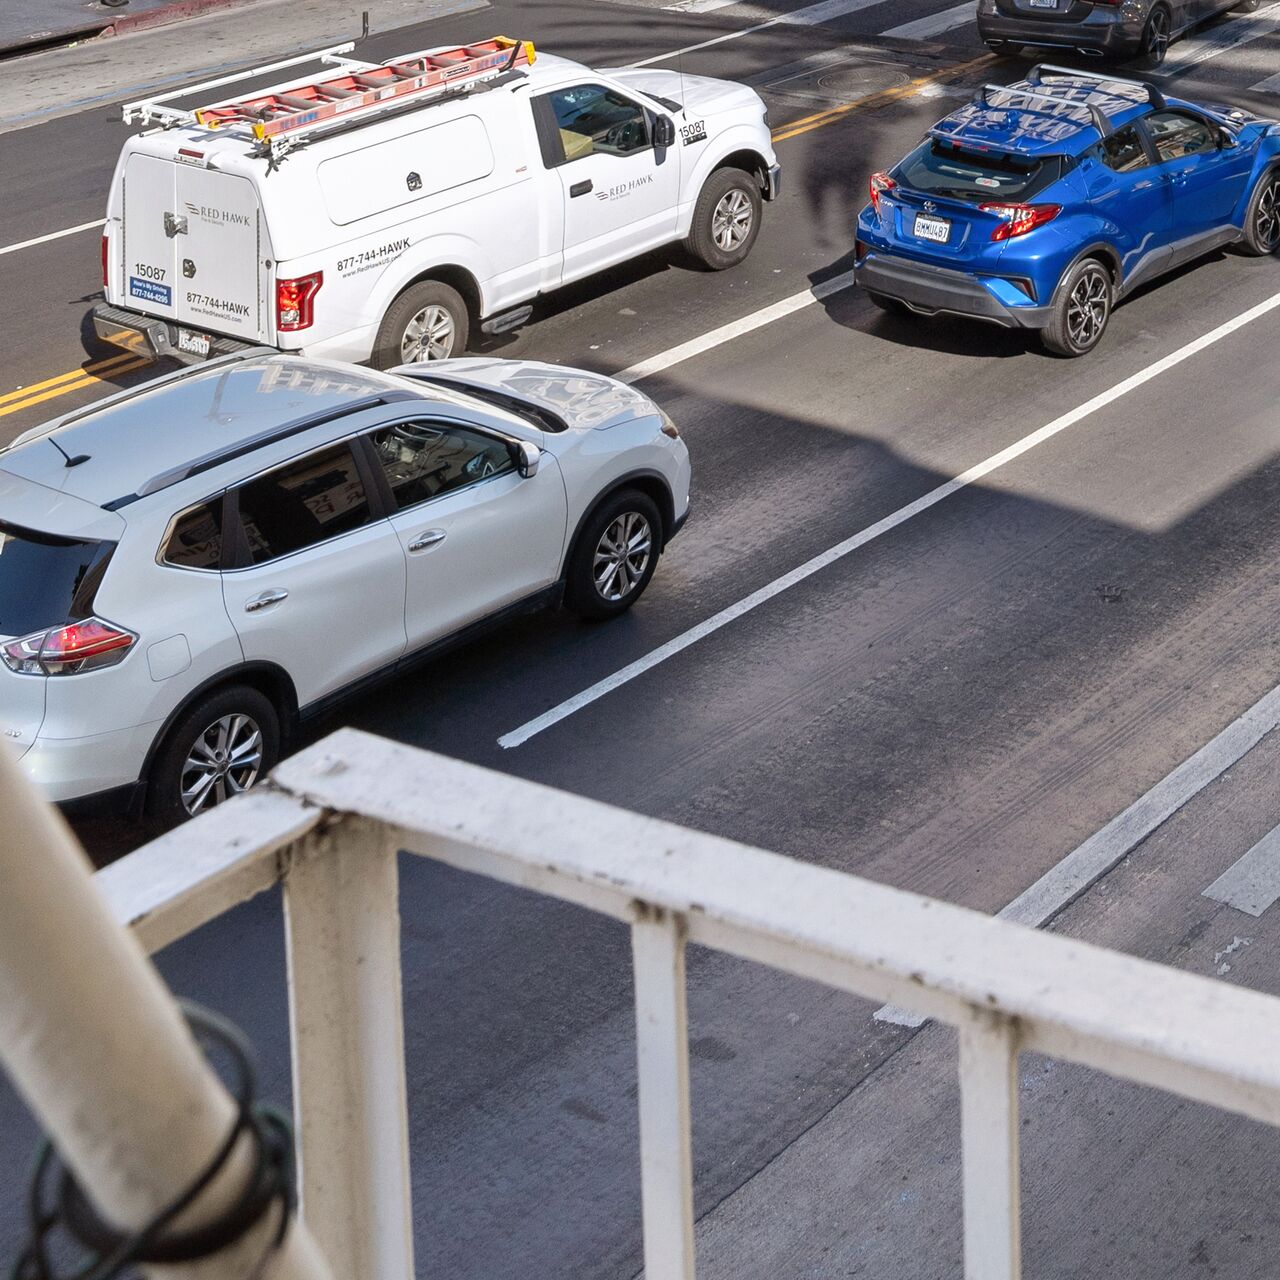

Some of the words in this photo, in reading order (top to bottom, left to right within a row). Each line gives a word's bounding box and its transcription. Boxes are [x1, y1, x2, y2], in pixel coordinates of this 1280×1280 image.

[679, 120, 705, 138] 15087
[609, 183, 627, 197] RED
[628, 174, 654, 190] HAWK
[201, 206, 220, 219] RED
[222, 210, 250, 226] HAWK
[337, 237, 411, 271] 877-744-HAWK
[135, 263, 166, 281] 15087
[186, 292, 250, 316] 877-744-HAWK
[190, 306, 242, 323] www.RedHawkUS.com
